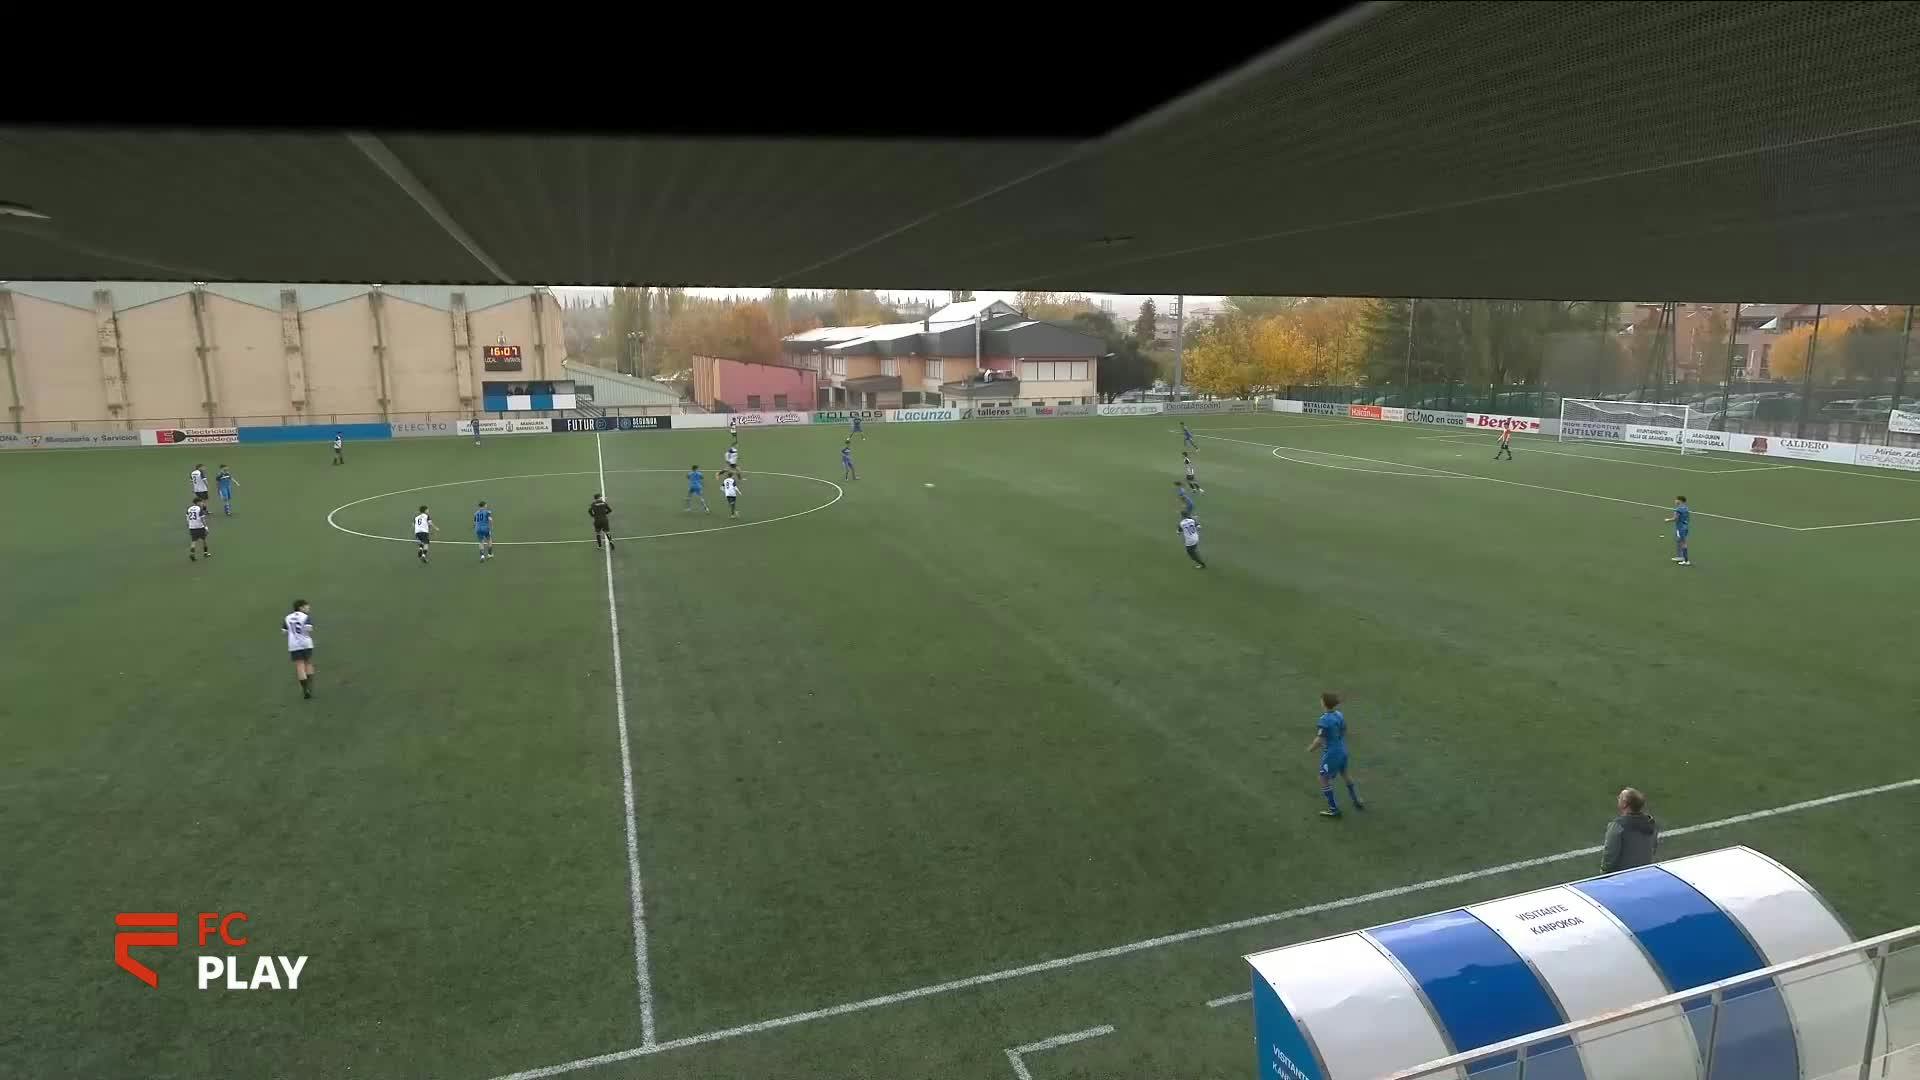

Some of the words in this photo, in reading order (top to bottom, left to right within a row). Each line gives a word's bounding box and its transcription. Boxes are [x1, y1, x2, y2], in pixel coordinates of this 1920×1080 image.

[977, 408, 1010, 416] talleres
[1478, 415, 1528, 430] Berlys
[1780, 439, 1829, 450] CALDERO
[1516, 904, 1568, 921] VISITANTE
[1530, 917, 1584, 935] KANPOKOA
